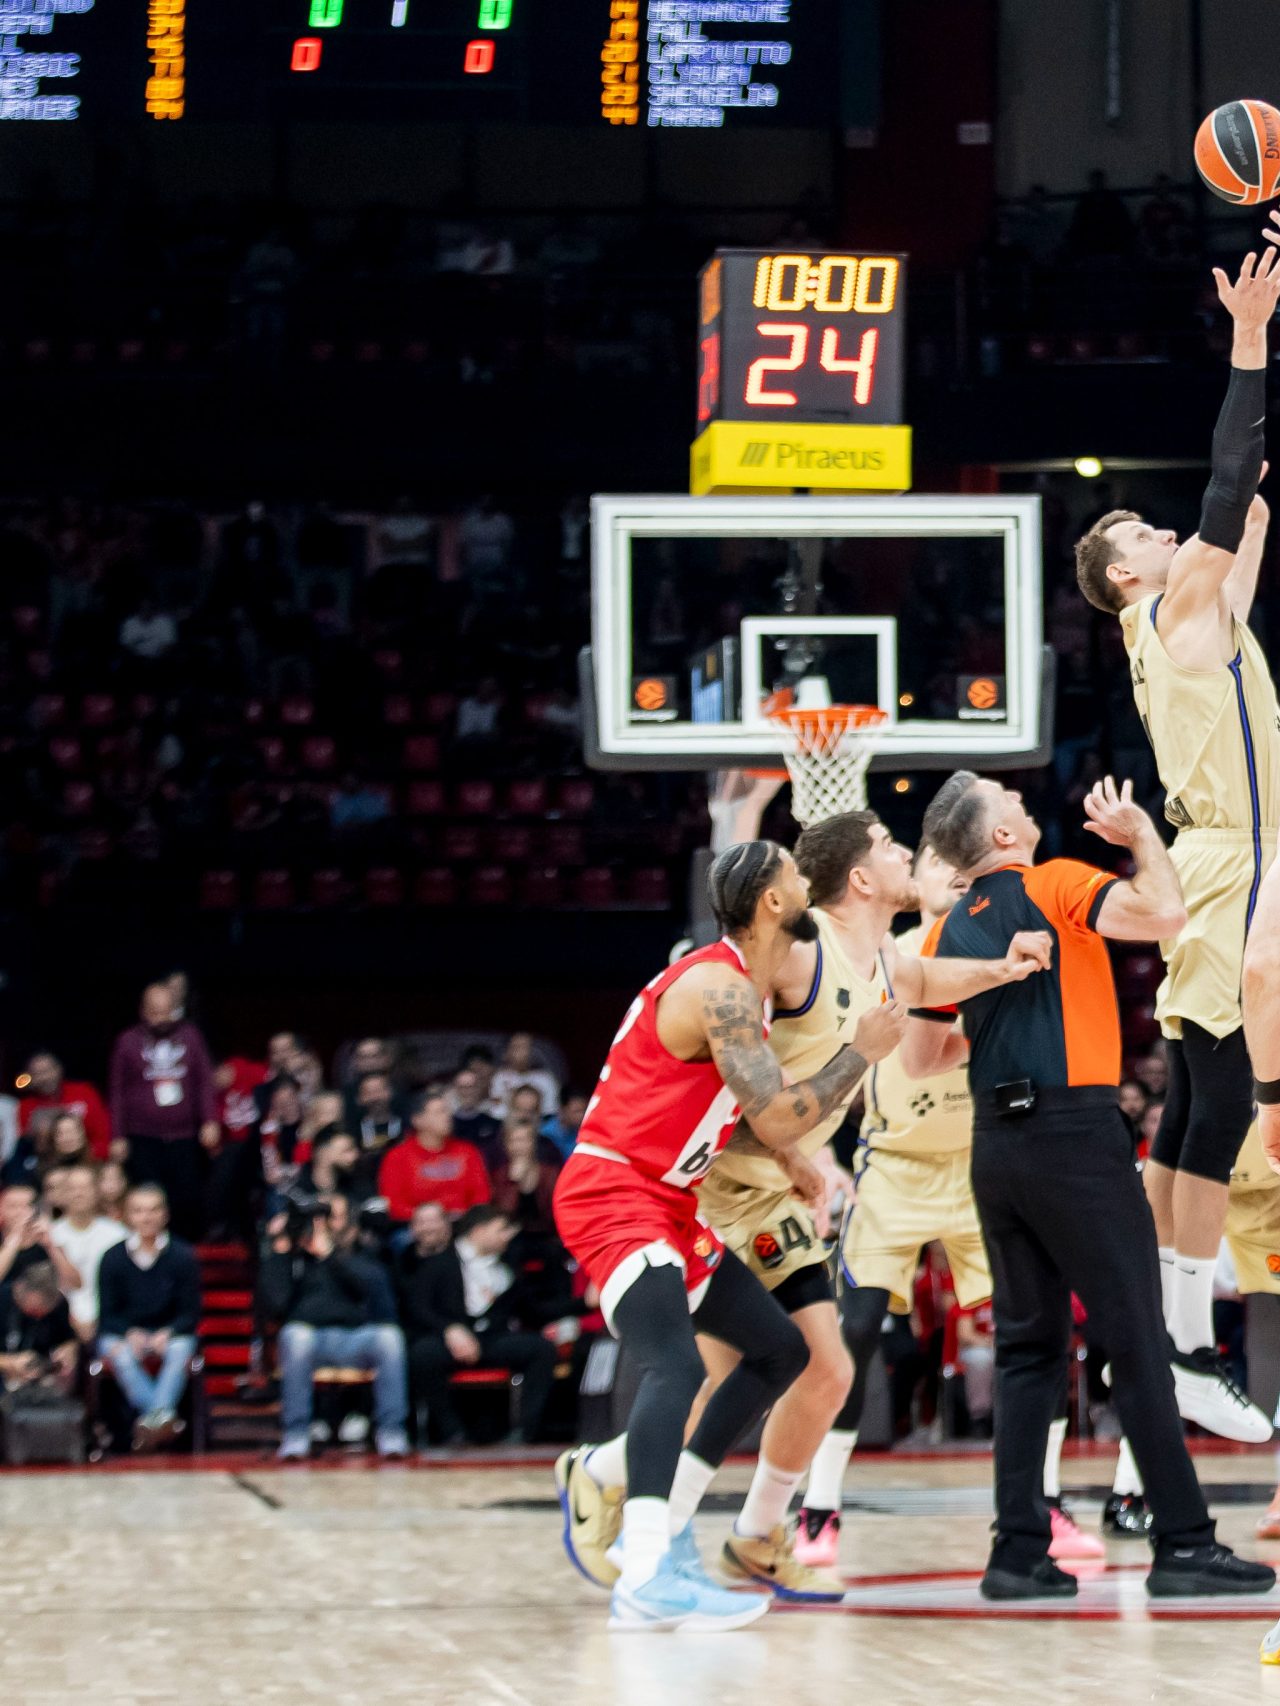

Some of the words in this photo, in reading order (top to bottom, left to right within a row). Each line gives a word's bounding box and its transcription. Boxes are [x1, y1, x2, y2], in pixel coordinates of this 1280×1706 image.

[753, 255, 899, 313] 10:00
[745, 322, 879, 405] 24
[775, 442, 885, 471] Piraeus
